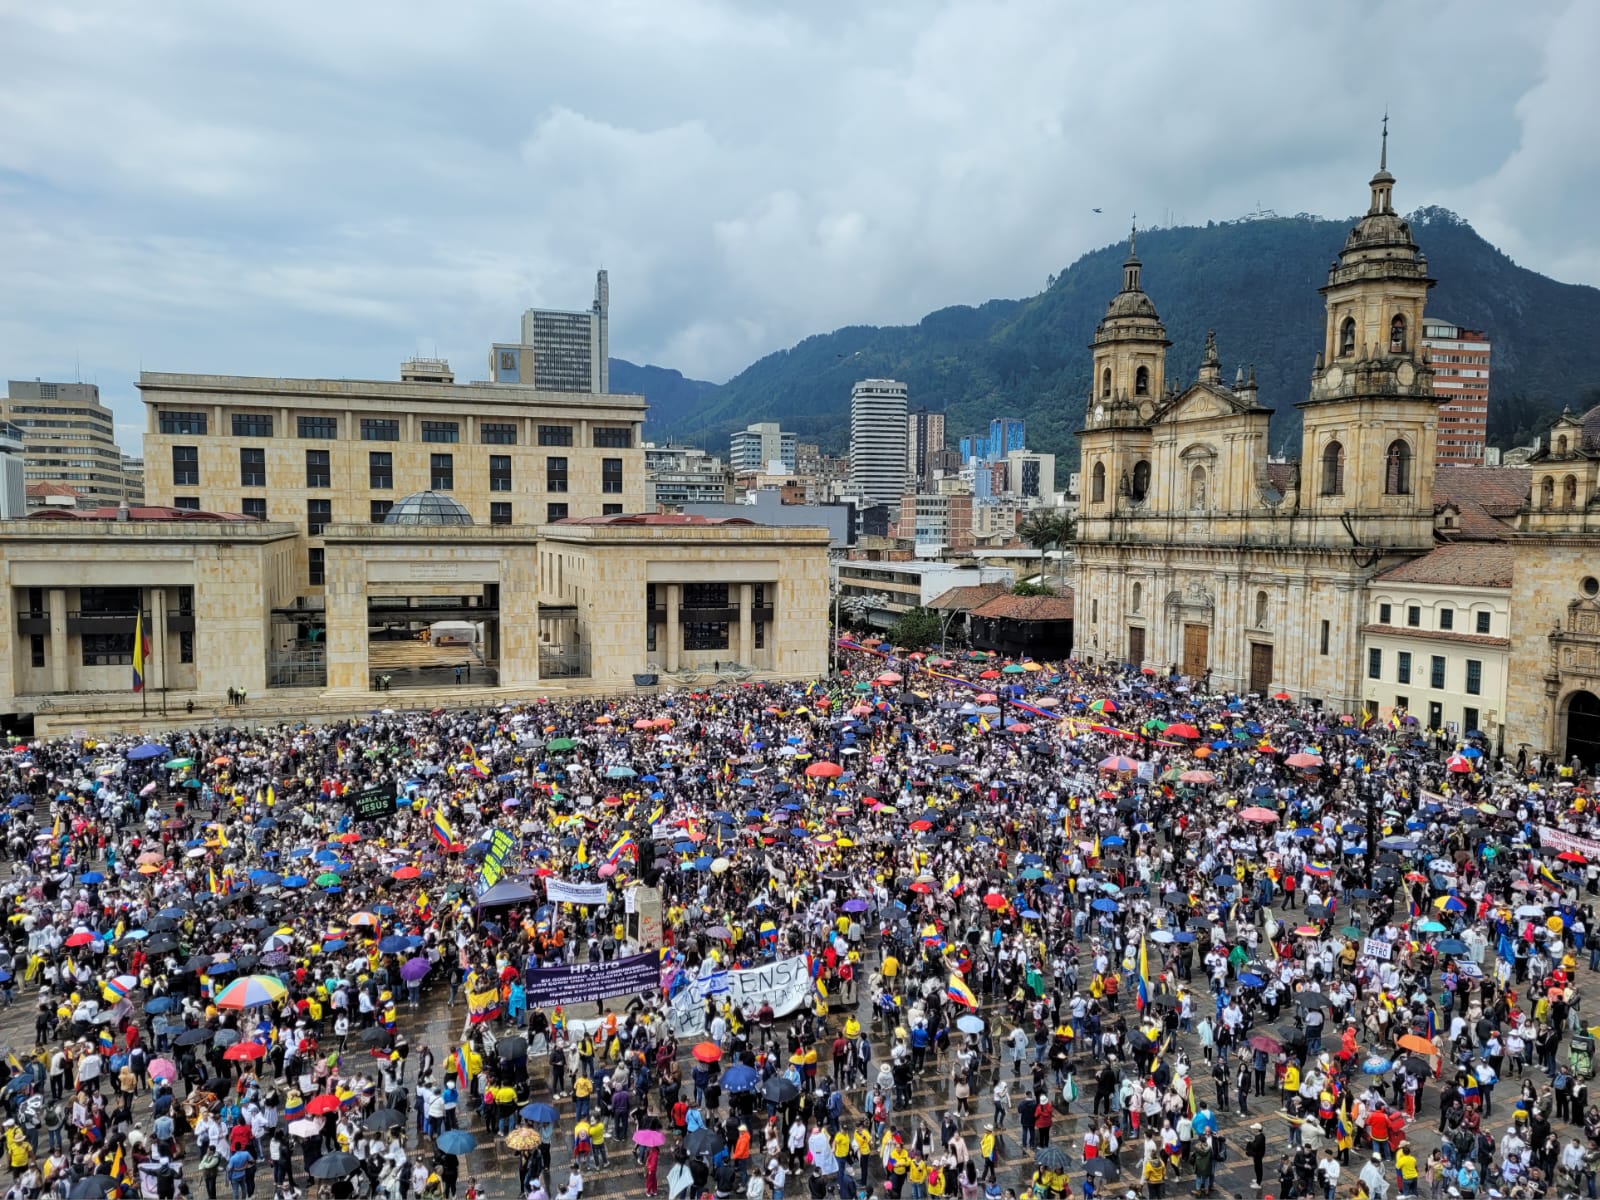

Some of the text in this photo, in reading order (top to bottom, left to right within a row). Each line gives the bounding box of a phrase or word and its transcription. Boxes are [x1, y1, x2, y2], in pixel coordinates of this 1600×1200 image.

[1367, 945, 1387, 957] PETRO
[570, 962, 619, 974] HPetro
[552, 974, 588, 982] GOBIERNO
[538, 998, 559, 1008] FUERZA
[599, 988, 625, 1000] RESERVAS
